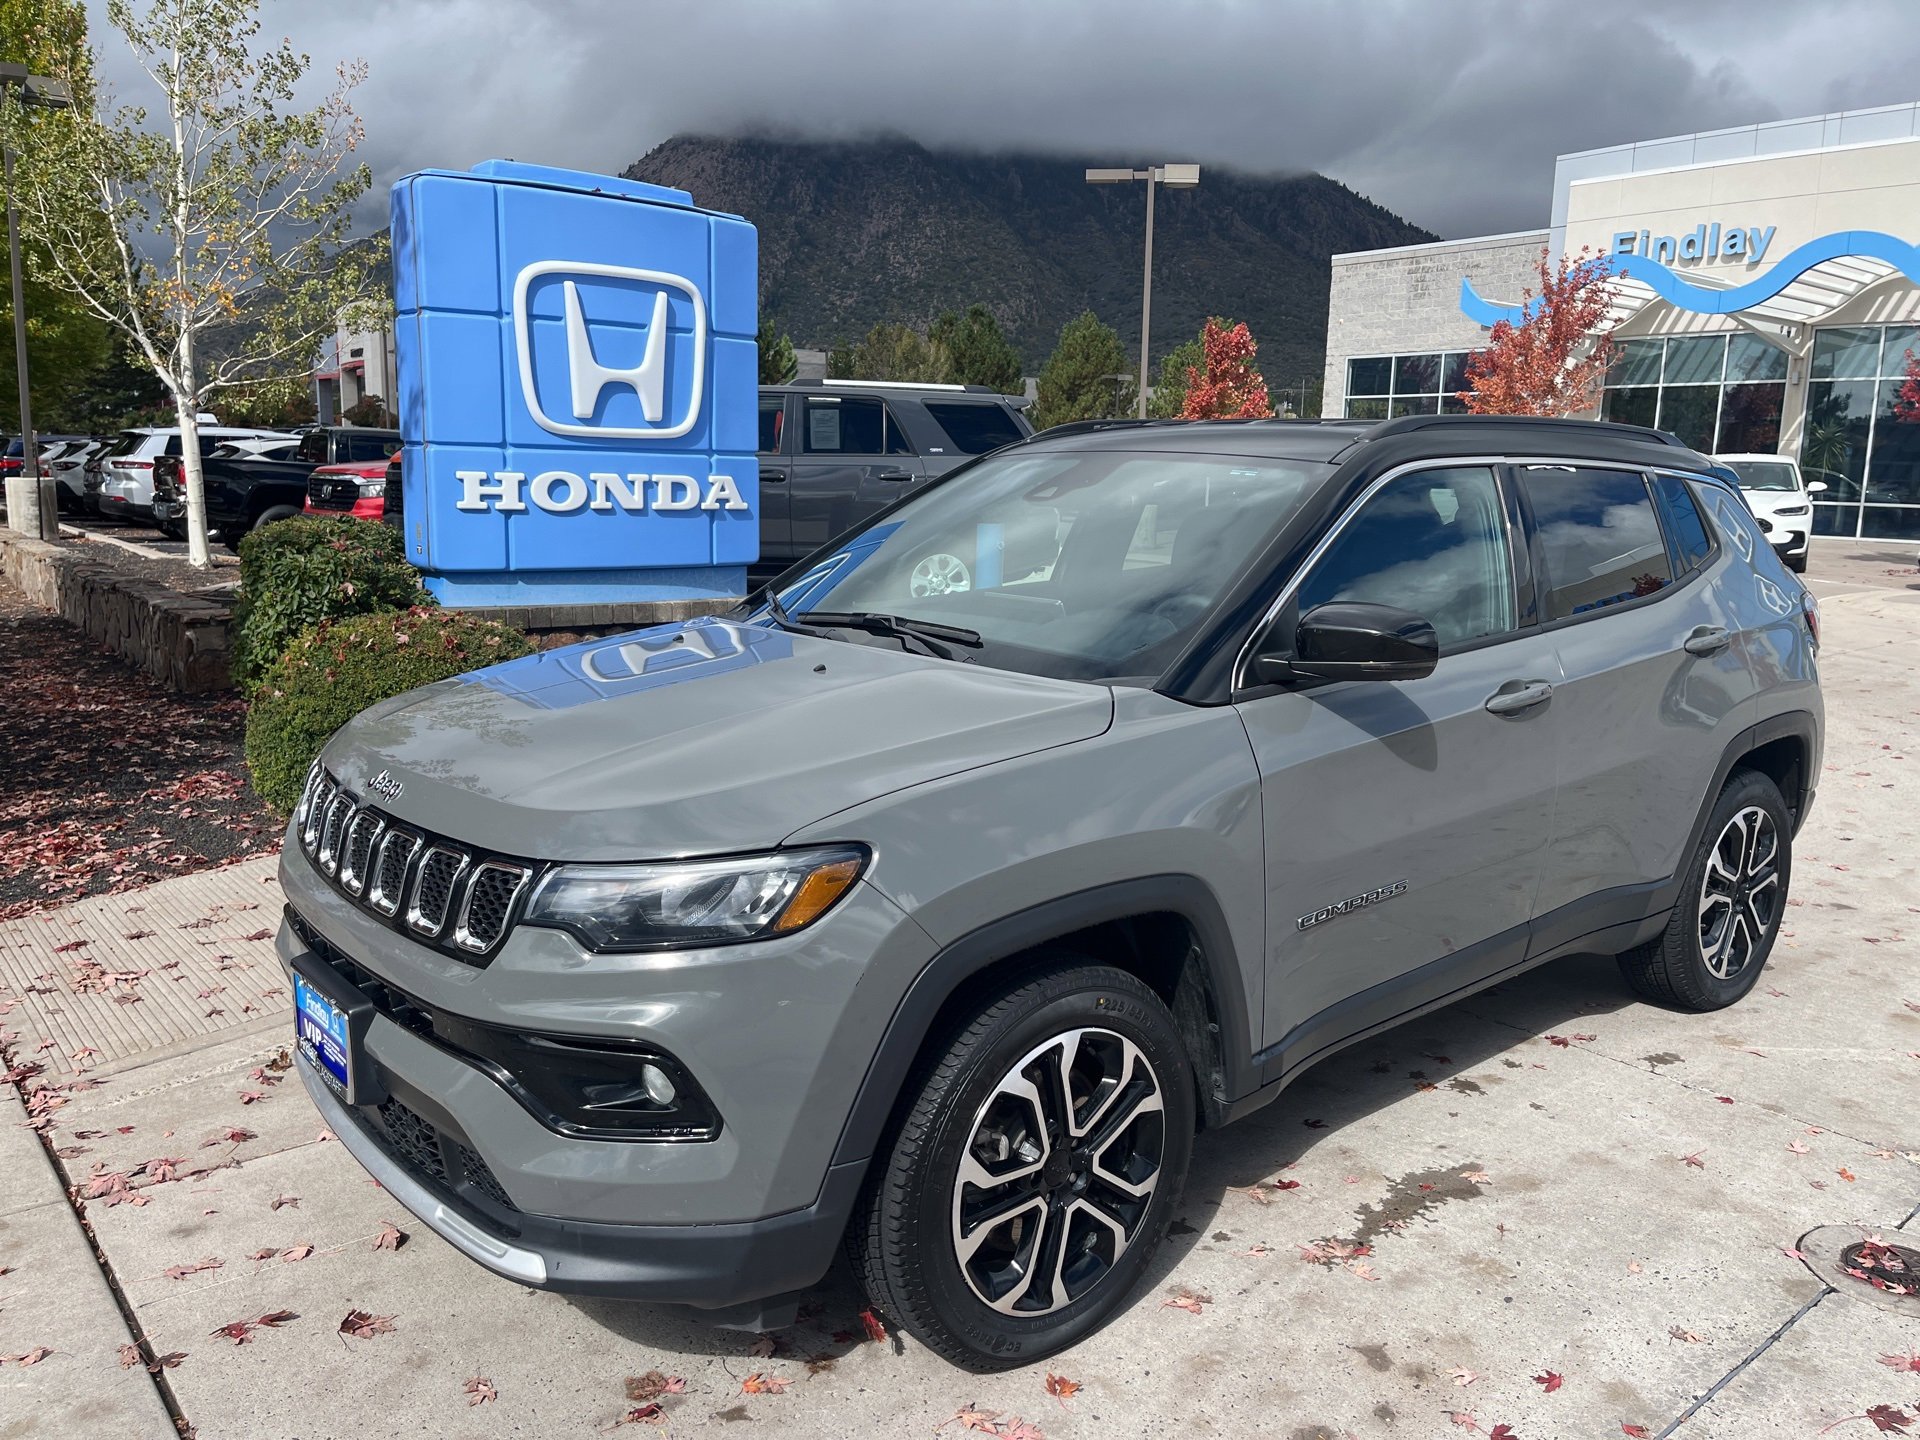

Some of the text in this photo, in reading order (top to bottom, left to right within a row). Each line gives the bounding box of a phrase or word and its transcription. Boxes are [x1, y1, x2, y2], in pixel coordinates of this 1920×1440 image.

[1612, 222, 1777, 264] Findlay
[455, 471, 749, 512] HONDA
[367, 769, 405, 804] Jeep
[1297, 879, 1409, 931] COMPASS
[303, 1017, 322, 1047] VIP
